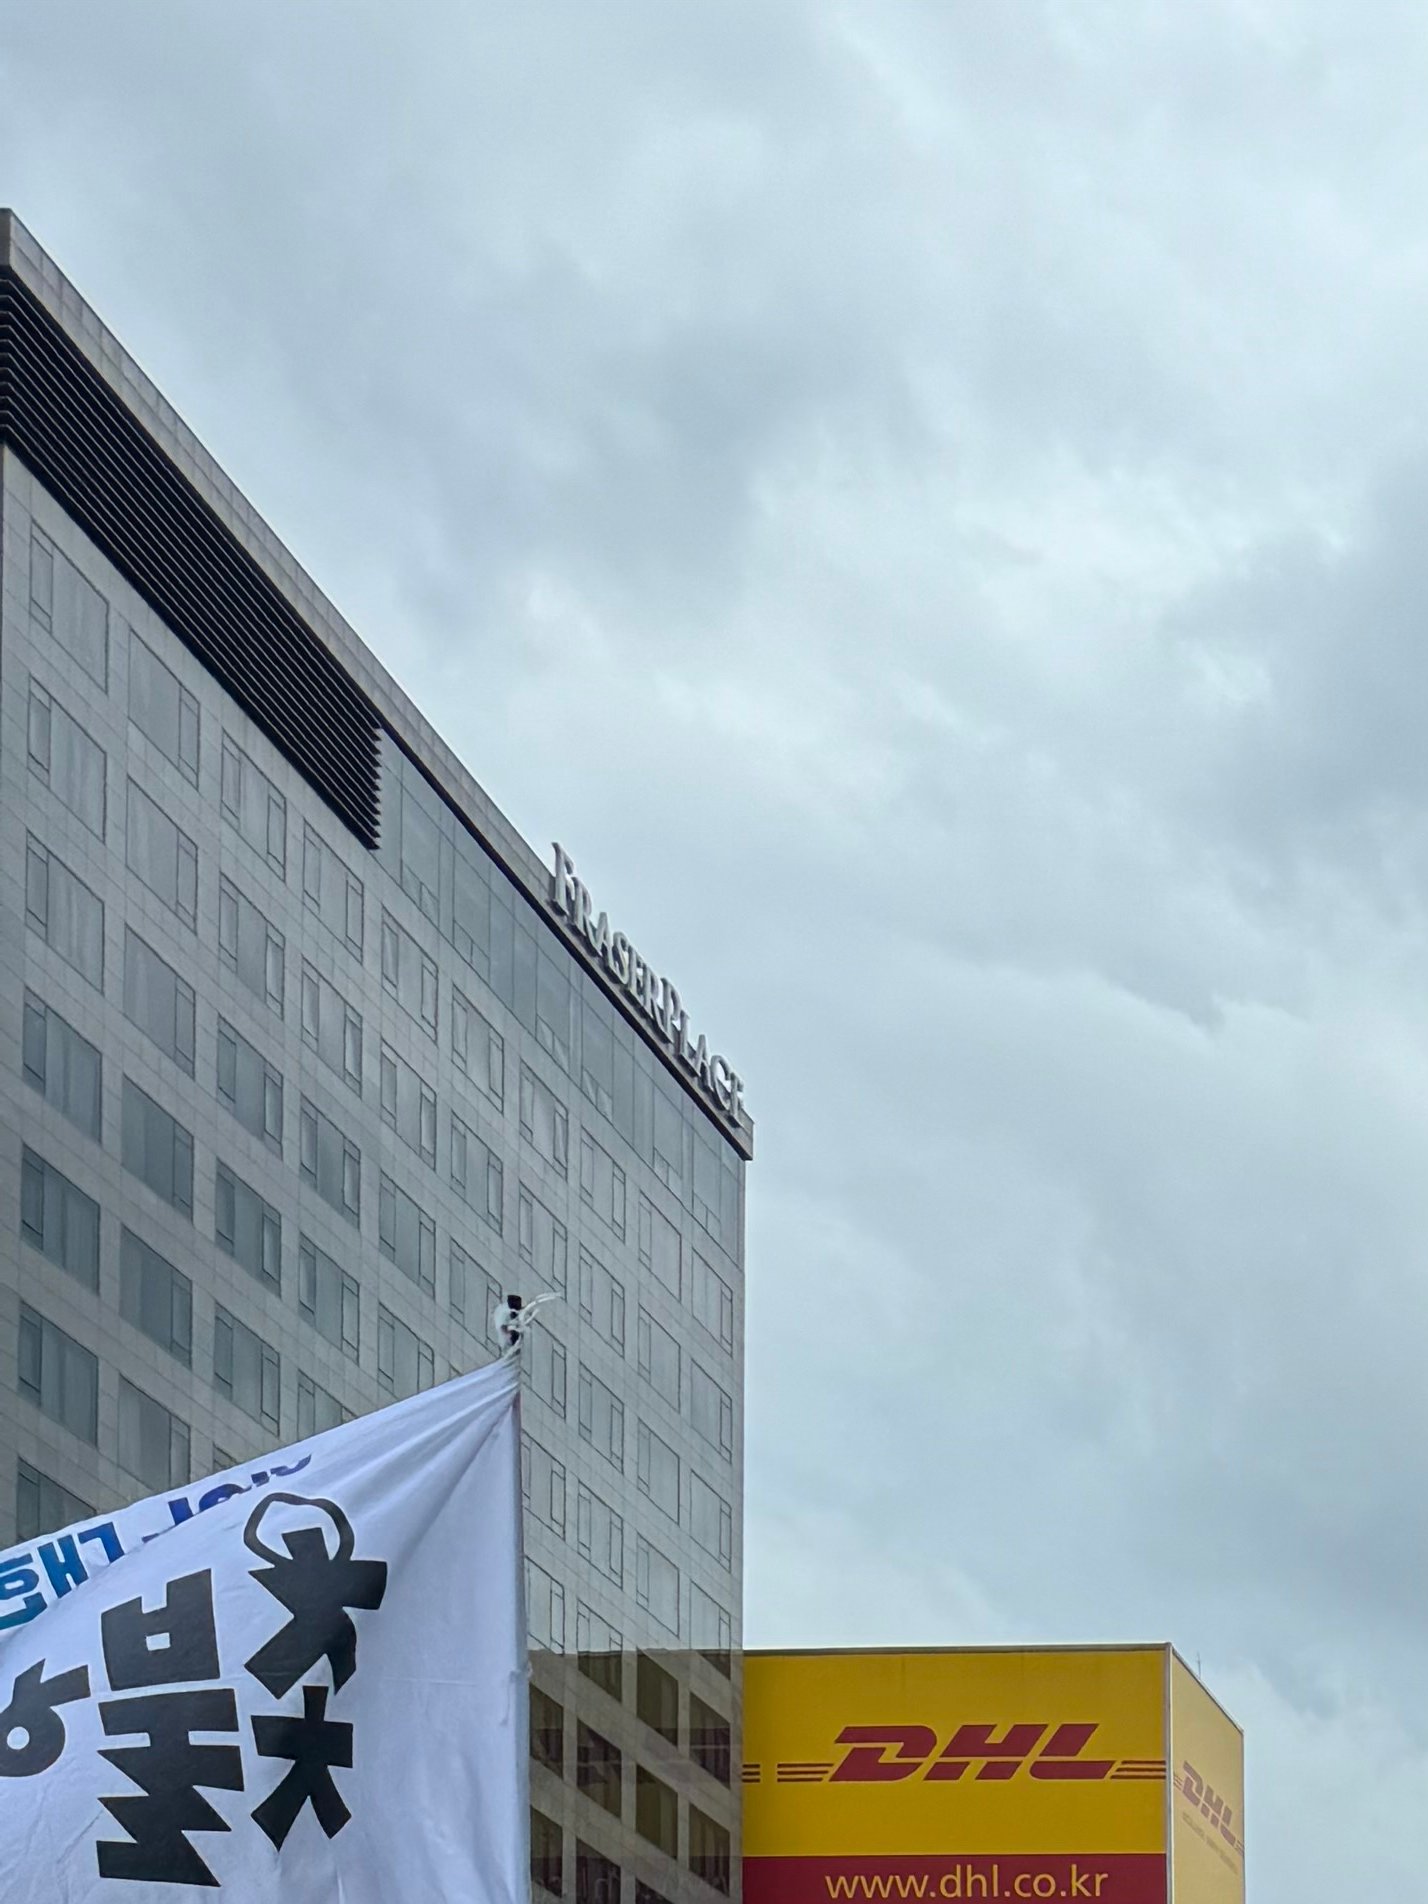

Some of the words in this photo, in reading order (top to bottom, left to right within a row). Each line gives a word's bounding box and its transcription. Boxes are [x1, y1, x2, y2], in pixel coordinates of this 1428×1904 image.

[659, 981, 744, 1128] PLACE
[828, 1723, 1117, 1782] DHL
[1181, 1760, 1237, 1848] DHL
[825, 1864, 1108, 1899] www.dhl.co.kr
